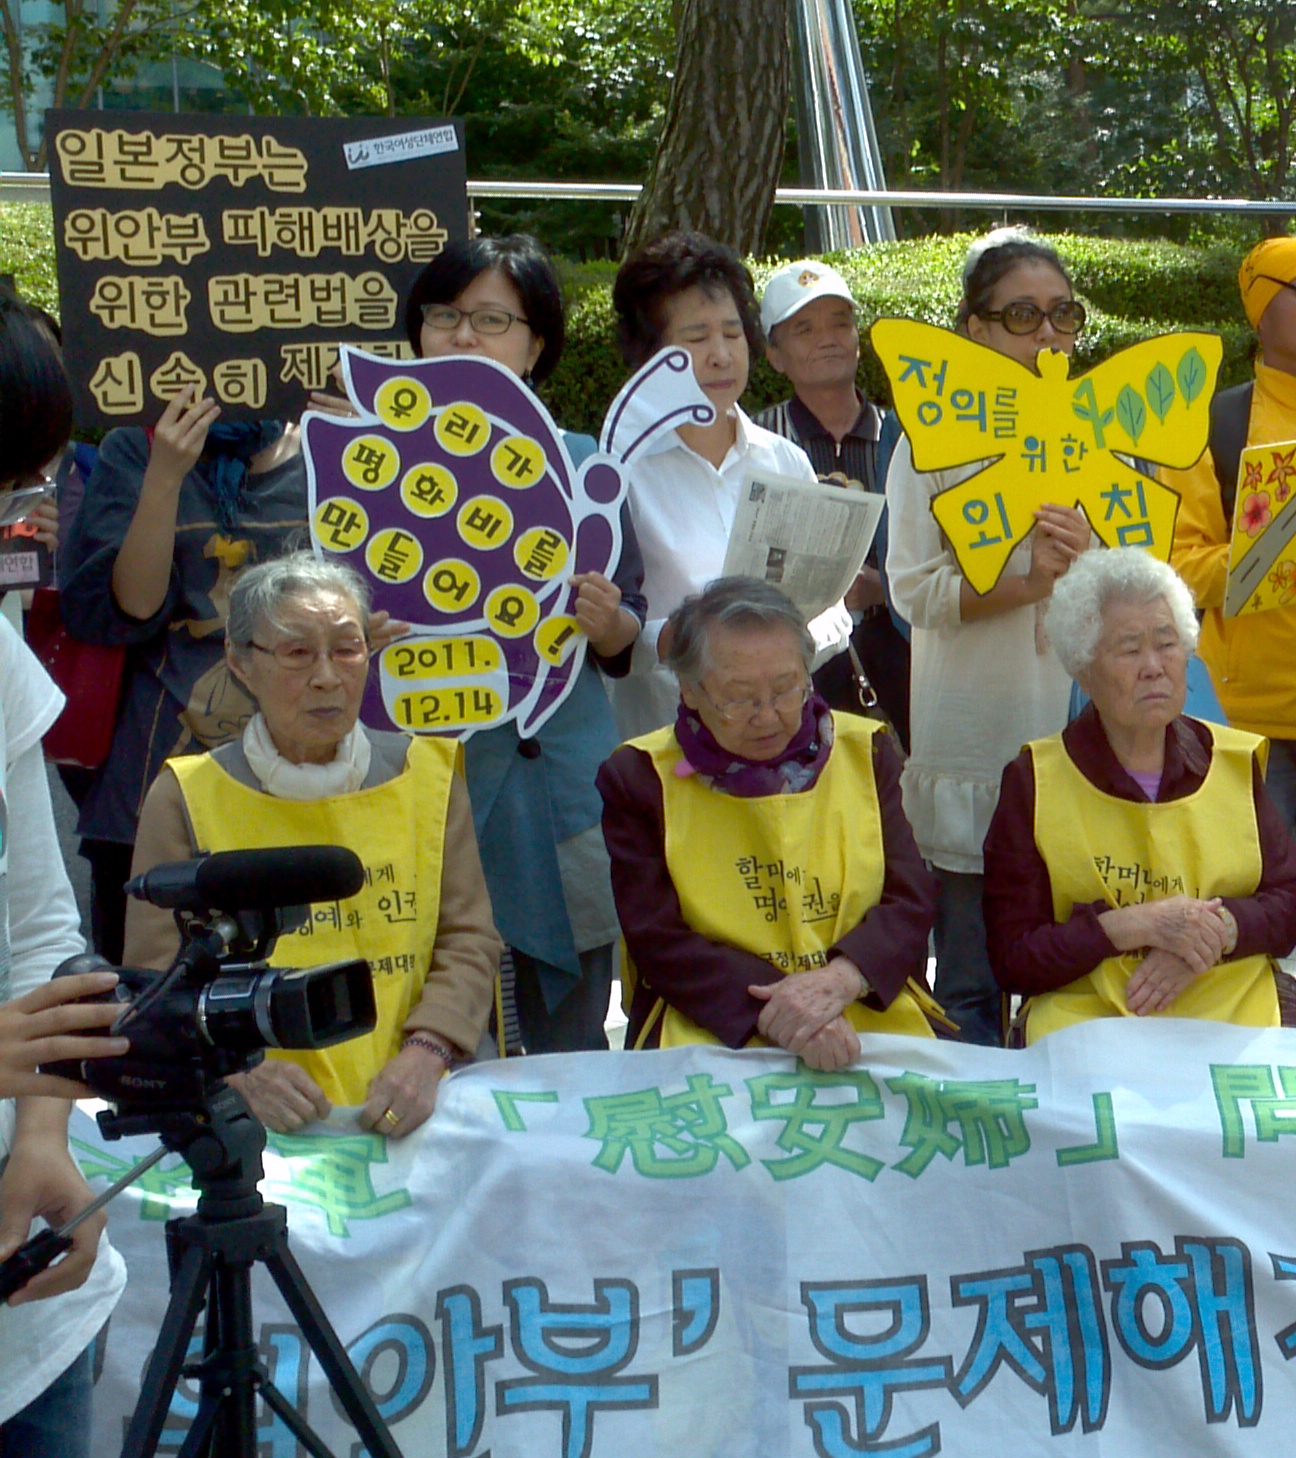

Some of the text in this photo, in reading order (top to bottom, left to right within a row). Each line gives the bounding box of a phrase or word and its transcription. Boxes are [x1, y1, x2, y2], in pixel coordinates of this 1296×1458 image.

[59, 130, 305, 190] 일본정부는
[67, 209, 446, 262] 위안부 피해배상을
[97, 275, 396, 331] 위한 관련법을
[898, 354, 1019, 440] 정의를
[1021, 433, 1088, 474] 위한
[352, 442, 561, 578] 평화비를
[394, 639, 492, 675] 2011.
[401, 689, 494, 725] 12.14
